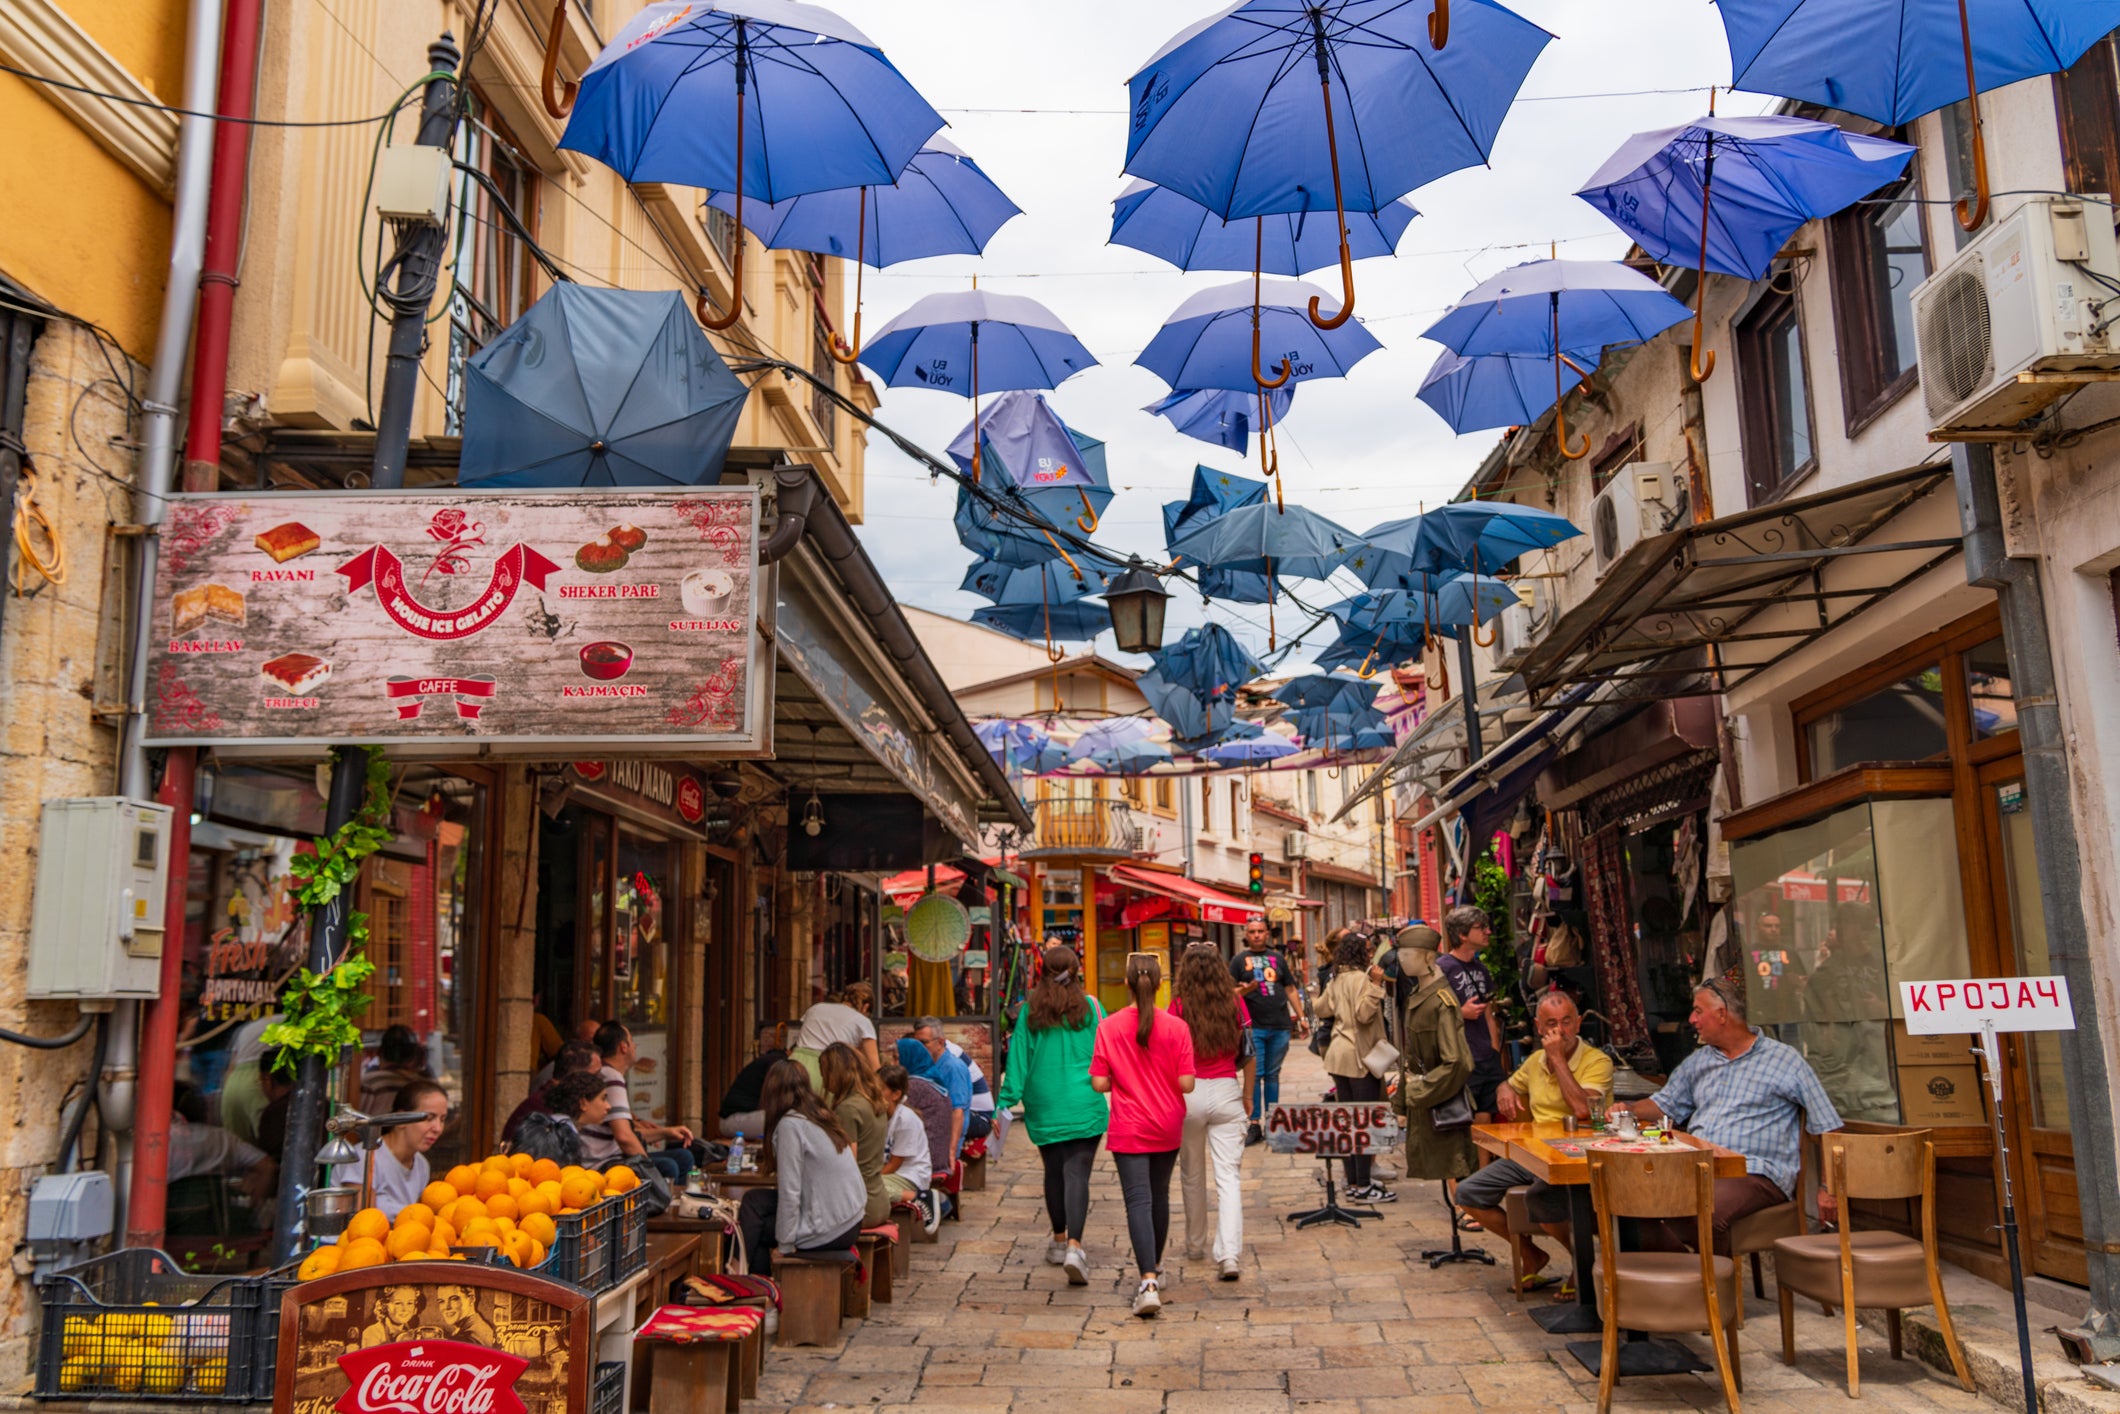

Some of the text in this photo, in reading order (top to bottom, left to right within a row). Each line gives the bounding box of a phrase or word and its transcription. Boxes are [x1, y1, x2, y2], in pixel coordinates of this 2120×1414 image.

[252, 569, 316, 581] RAVANI
[558, 584, 660, 598] SHEKER PARE
[390, 591, 505, 633] HOUSE ICE GELATO
[669, 620, 741, 633] SUTLIJAÇ
[418, 680, 459, 693] CAFFE
[562, 685, 648, 699] KAJMAÇIN
[642, 760, 672, 806] MAKO
[207, 926, 268, 978] Fresh
[1909, 980, 2060, 1012] КРОЈАЧ
[1270, 1105, 1388, 1133] ANTIQUE
[1295, 1131, 1371, 1154] SHOP
[401, 1359, 436, 1368] DRINK
[357, 1362, 502, 1414] Coca-Cola
